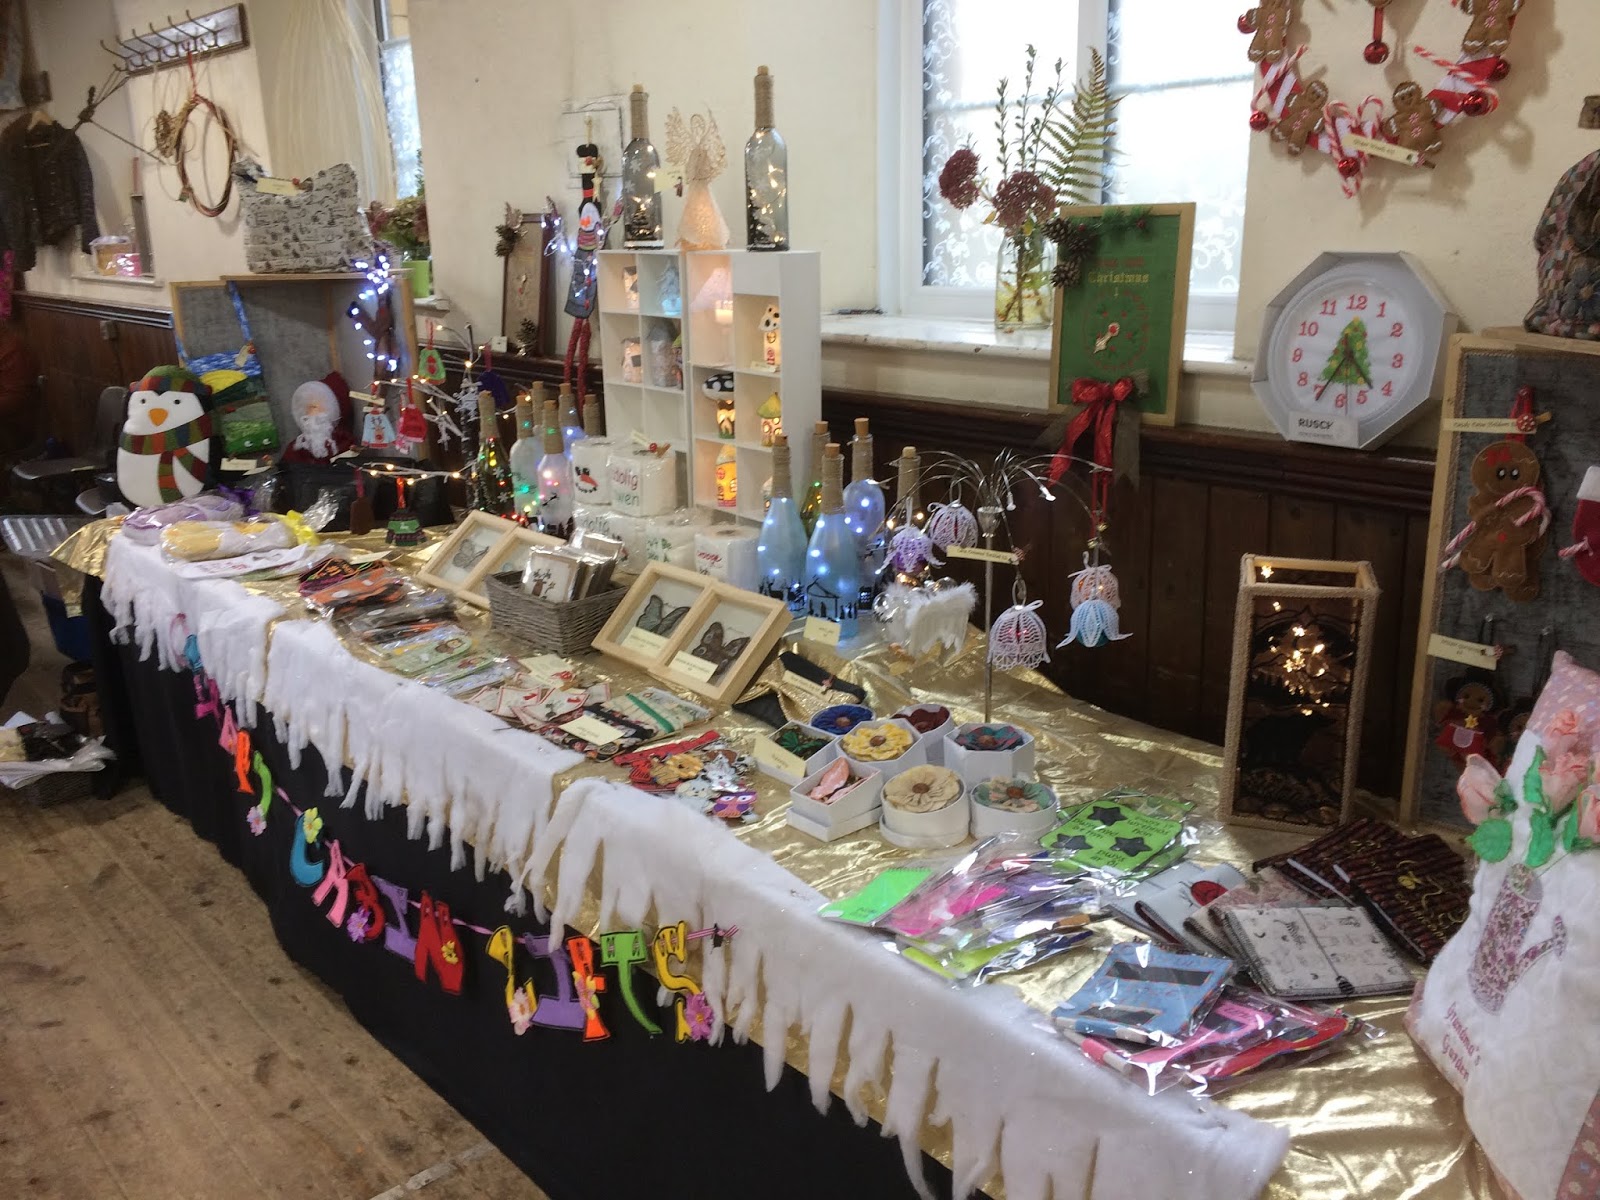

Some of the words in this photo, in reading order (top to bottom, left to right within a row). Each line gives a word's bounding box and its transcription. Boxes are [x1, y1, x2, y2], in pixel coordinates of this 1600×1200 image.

[1087, 271, 1150, 285] Christmas
[1319, 299, 1337, 316] 11
[1346, 295, 1368, 310] 12
[1376, 301, 1387, 318] 1
[1299, 321, 1319, 337] 10
[1390, 322, 1403, 337] 2
[1292, 348, 1303, 363] 9
[1391, 353, 1404, 369] 3
[1297, 372, 1308, 387] 8
[1313, 384, 1325, 401] 7
[1381, 380, 1393, 397] 4
[1335, 394, 1347, 408] 6
[1356, 390, 1368, 405] 5
